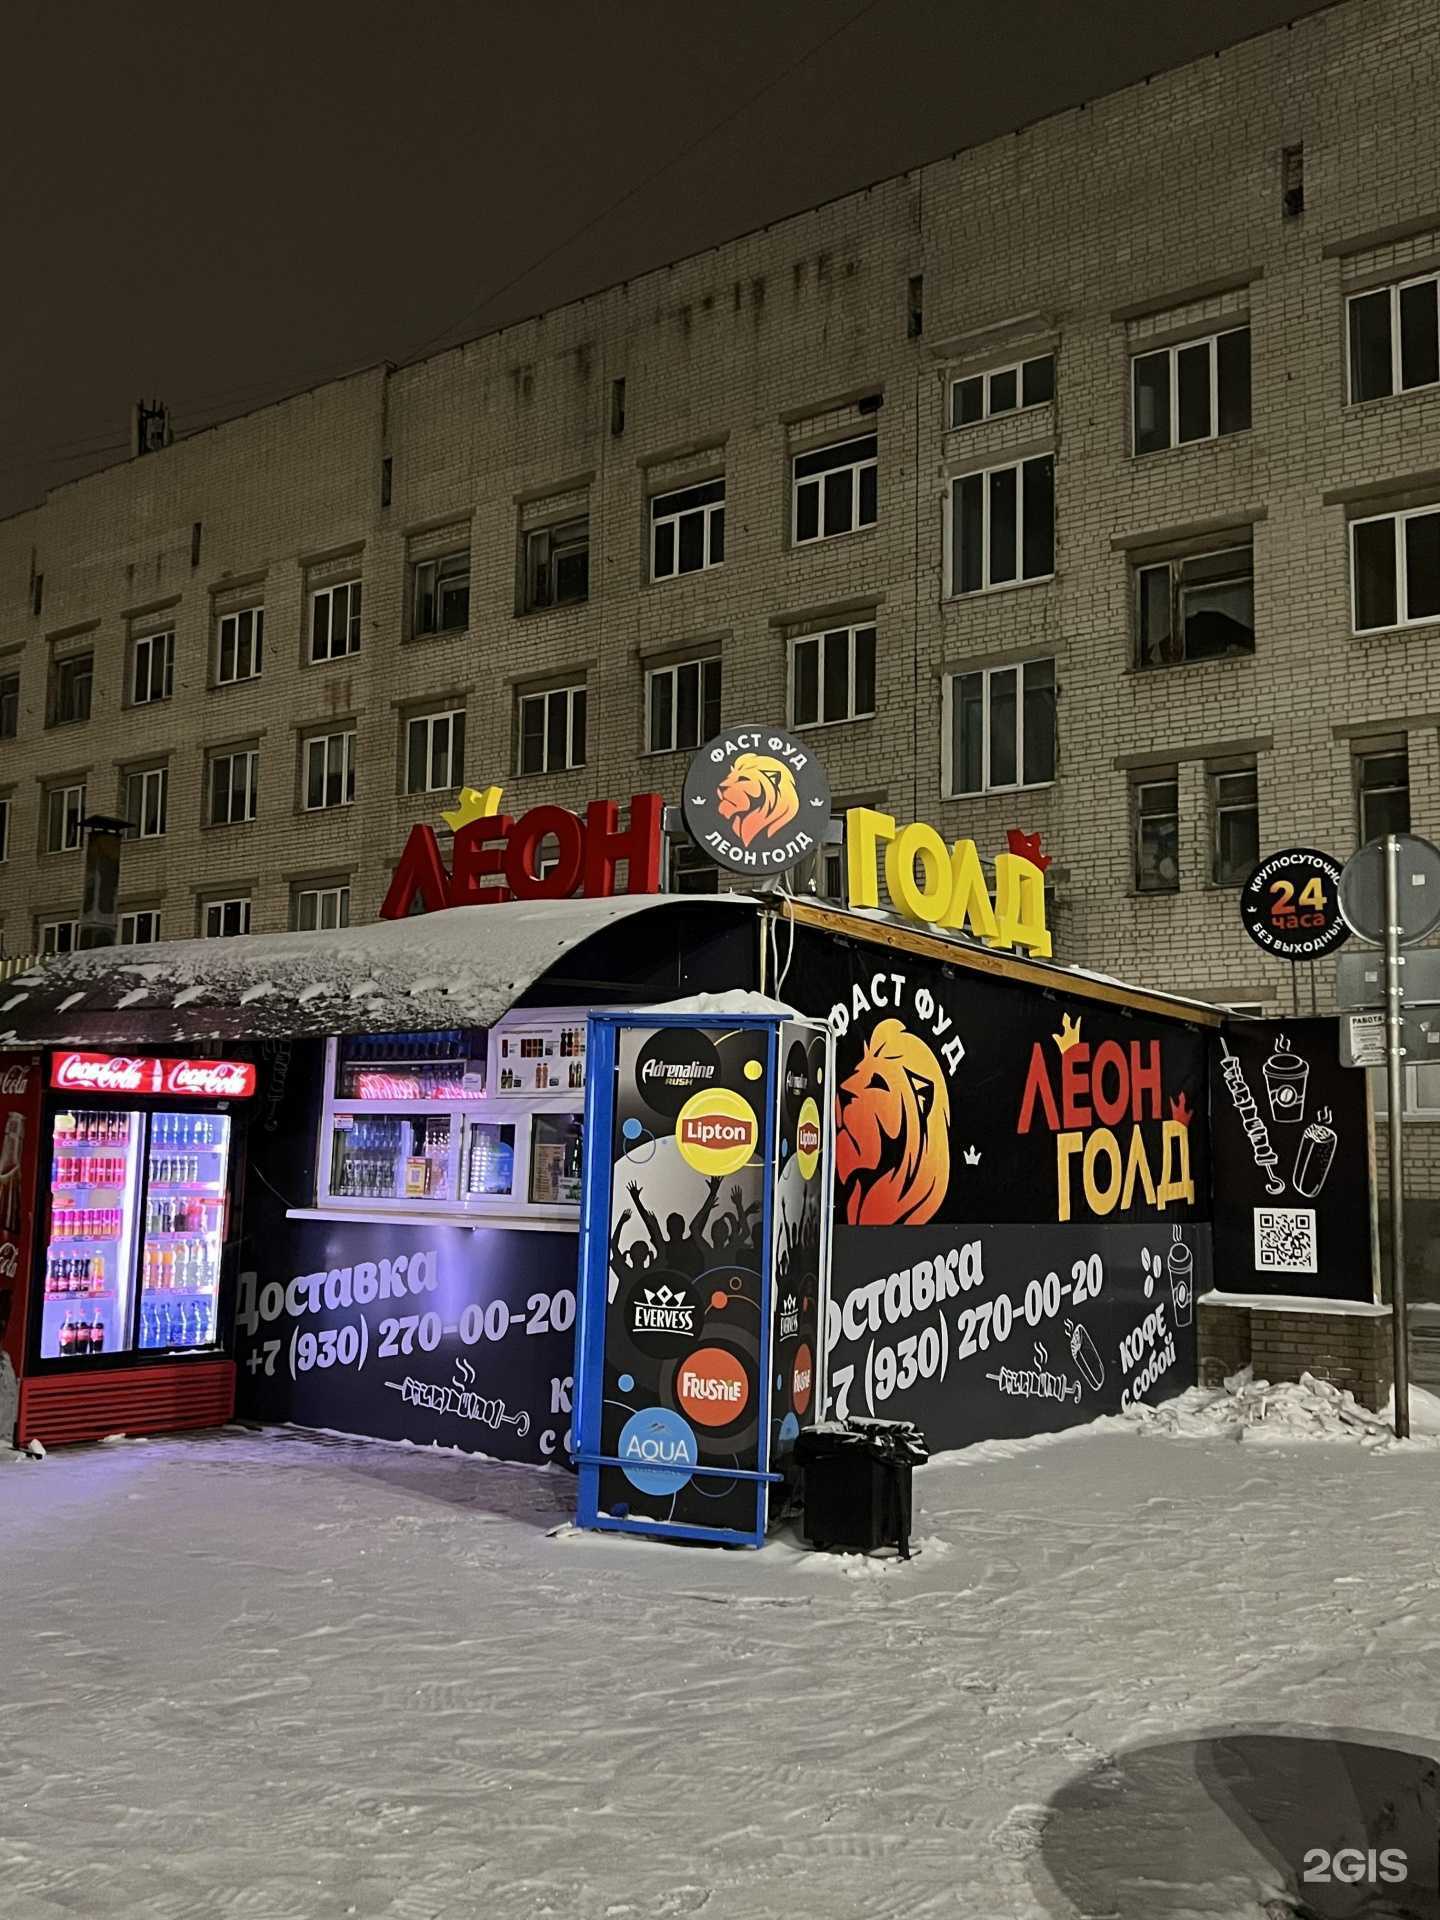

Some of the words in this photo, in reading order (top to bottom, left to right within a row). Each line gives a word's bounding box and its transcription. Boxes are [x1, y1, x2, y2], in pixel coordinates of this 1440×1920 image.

[710, 734, 762, 763] ФАСТ
[767, 737, 808, 771] ФУД
[705, 831, 757, 866] ЛЕОН
[762, 832, 814, 866] ГОЛД
[380, 792, 664, 919] ЛЕОН
[846, 807, 1053, 959] ГОЛД
[1269, 877, 1328, 915] 24
[1252, 922, 1272, 945] БЕЗ
[1273, 916, 1344, 954] ВЫХОДНЫХ
[1271, 912, 1326, 930] часа
[827, 972, 906, 1038] ФАСТ
[914, 988, 966, 1077] ФУД
[57, 1054, 146, 1090] Coca-Cola
[167, 1060, 249, 1094] Coca-Cola
[641, 1058, 715, 1084] Adrenaline
[665, 1077, 694, 1086] RUSH
[1017, 1040, 1163, 1134] ЛЕОН
[687, 1121, 746, 1146] Lipton
[800, 1129, 818, 1150] Lipton
[1057, 1119, 1195, 1222] ГОЛД
[235, 1250, 440, 1337] Доставка
[825, 1240, 982, 1353] оставка
[246, 1339, 282, 1376] +7
[289, 1313, 369, 1381] (930)
[378, 1289, 577, 1358] 270-00-20
[634, 1306, 693, 1330] EVERVESS
[865, 1308, 949, 1418] (930)
[958, 1253, 1102, 1360] 270-00-20
[1120, 1302, 1166, 1375] КОФЕ
[1133, 1331, 1176, 1400] собой
[682, 1372, 742, 1402] FRUSTYLE
[626, 1434, 690, 1463] AQUA
